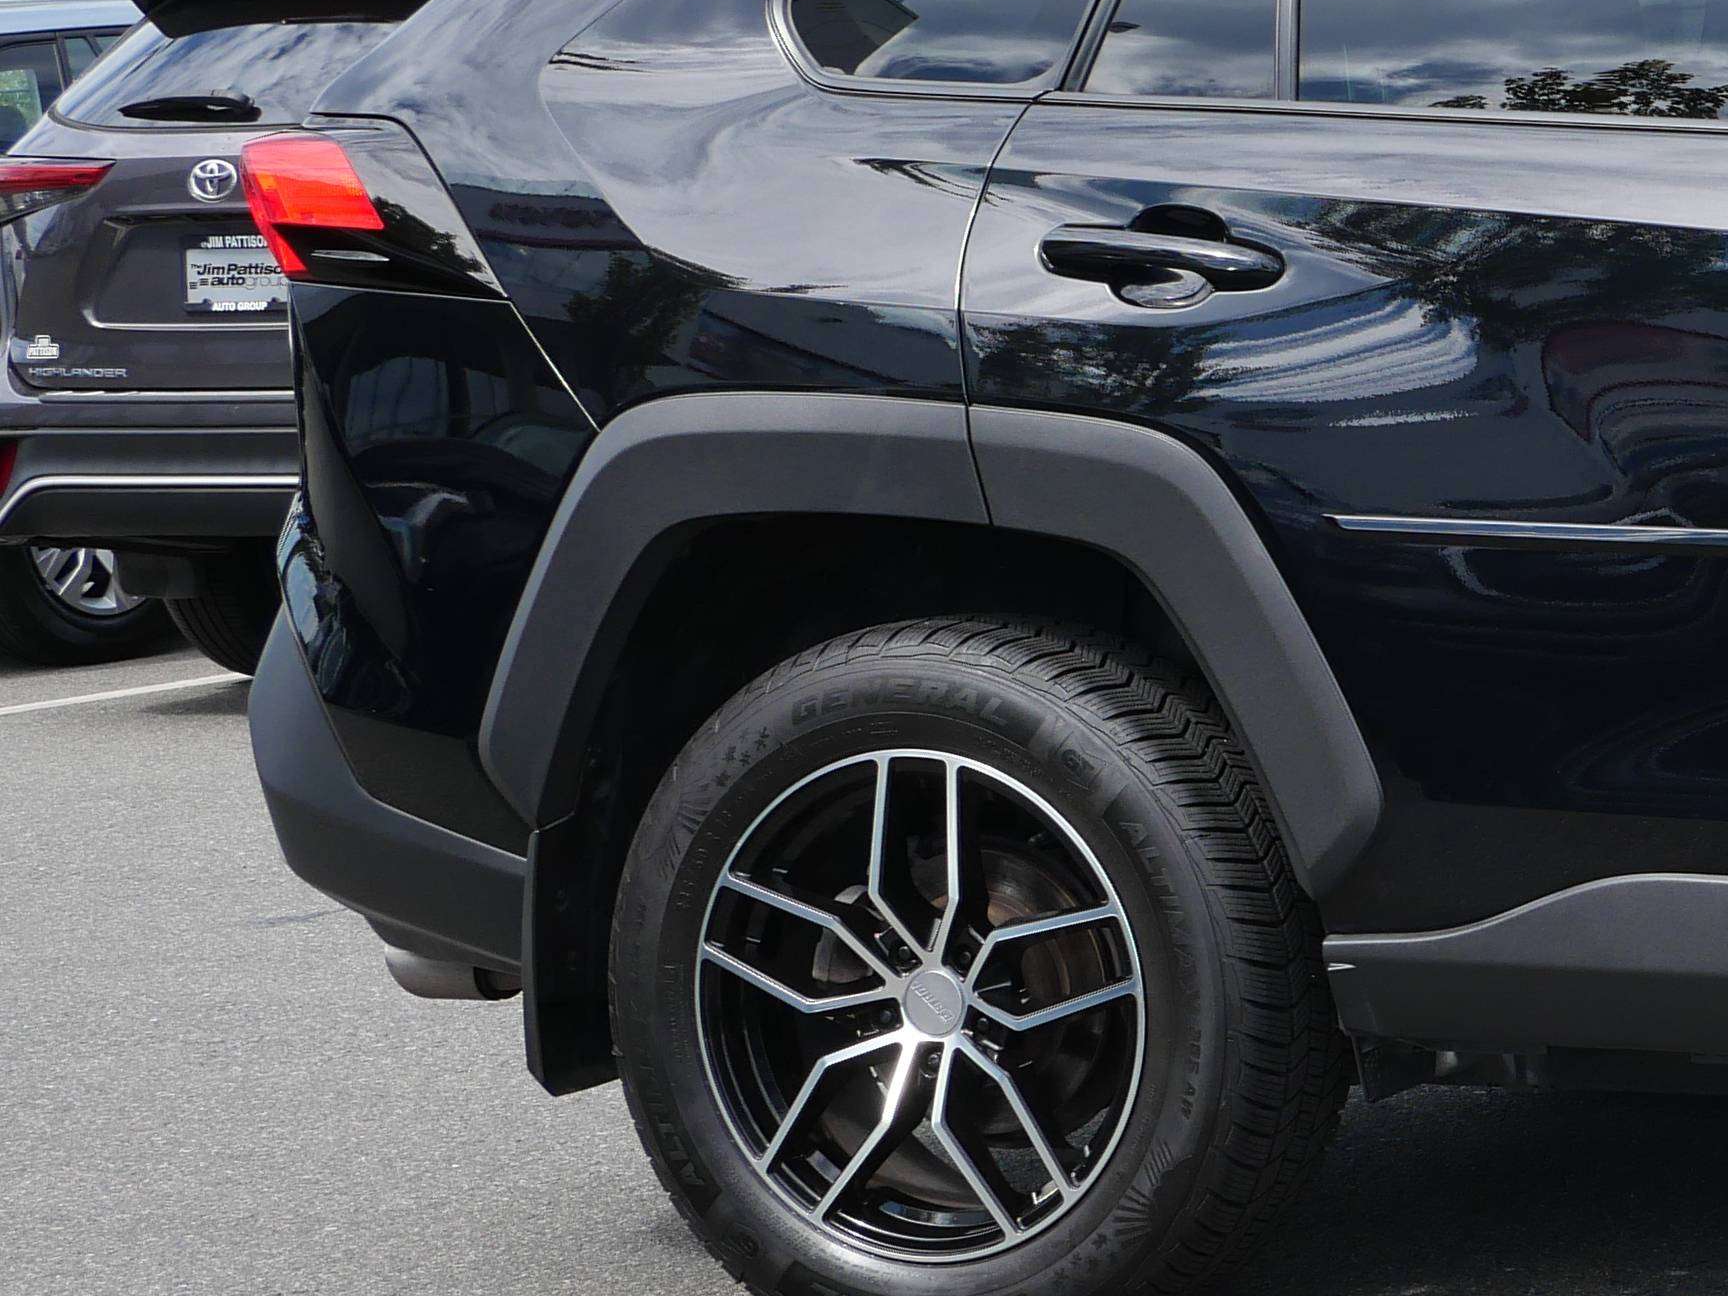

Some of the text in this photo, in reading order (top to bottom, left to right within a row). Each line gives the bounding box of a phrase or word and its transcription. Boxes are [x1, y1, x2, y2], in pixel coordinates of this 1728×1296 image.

[206, 235, 268, 248] JIM PATTISO
[227, 263, 283, 276] Pattiso
[212, 301, 268, 311] AUTO GROUP
[29, 367, 128, 378] HIGHLANDER
